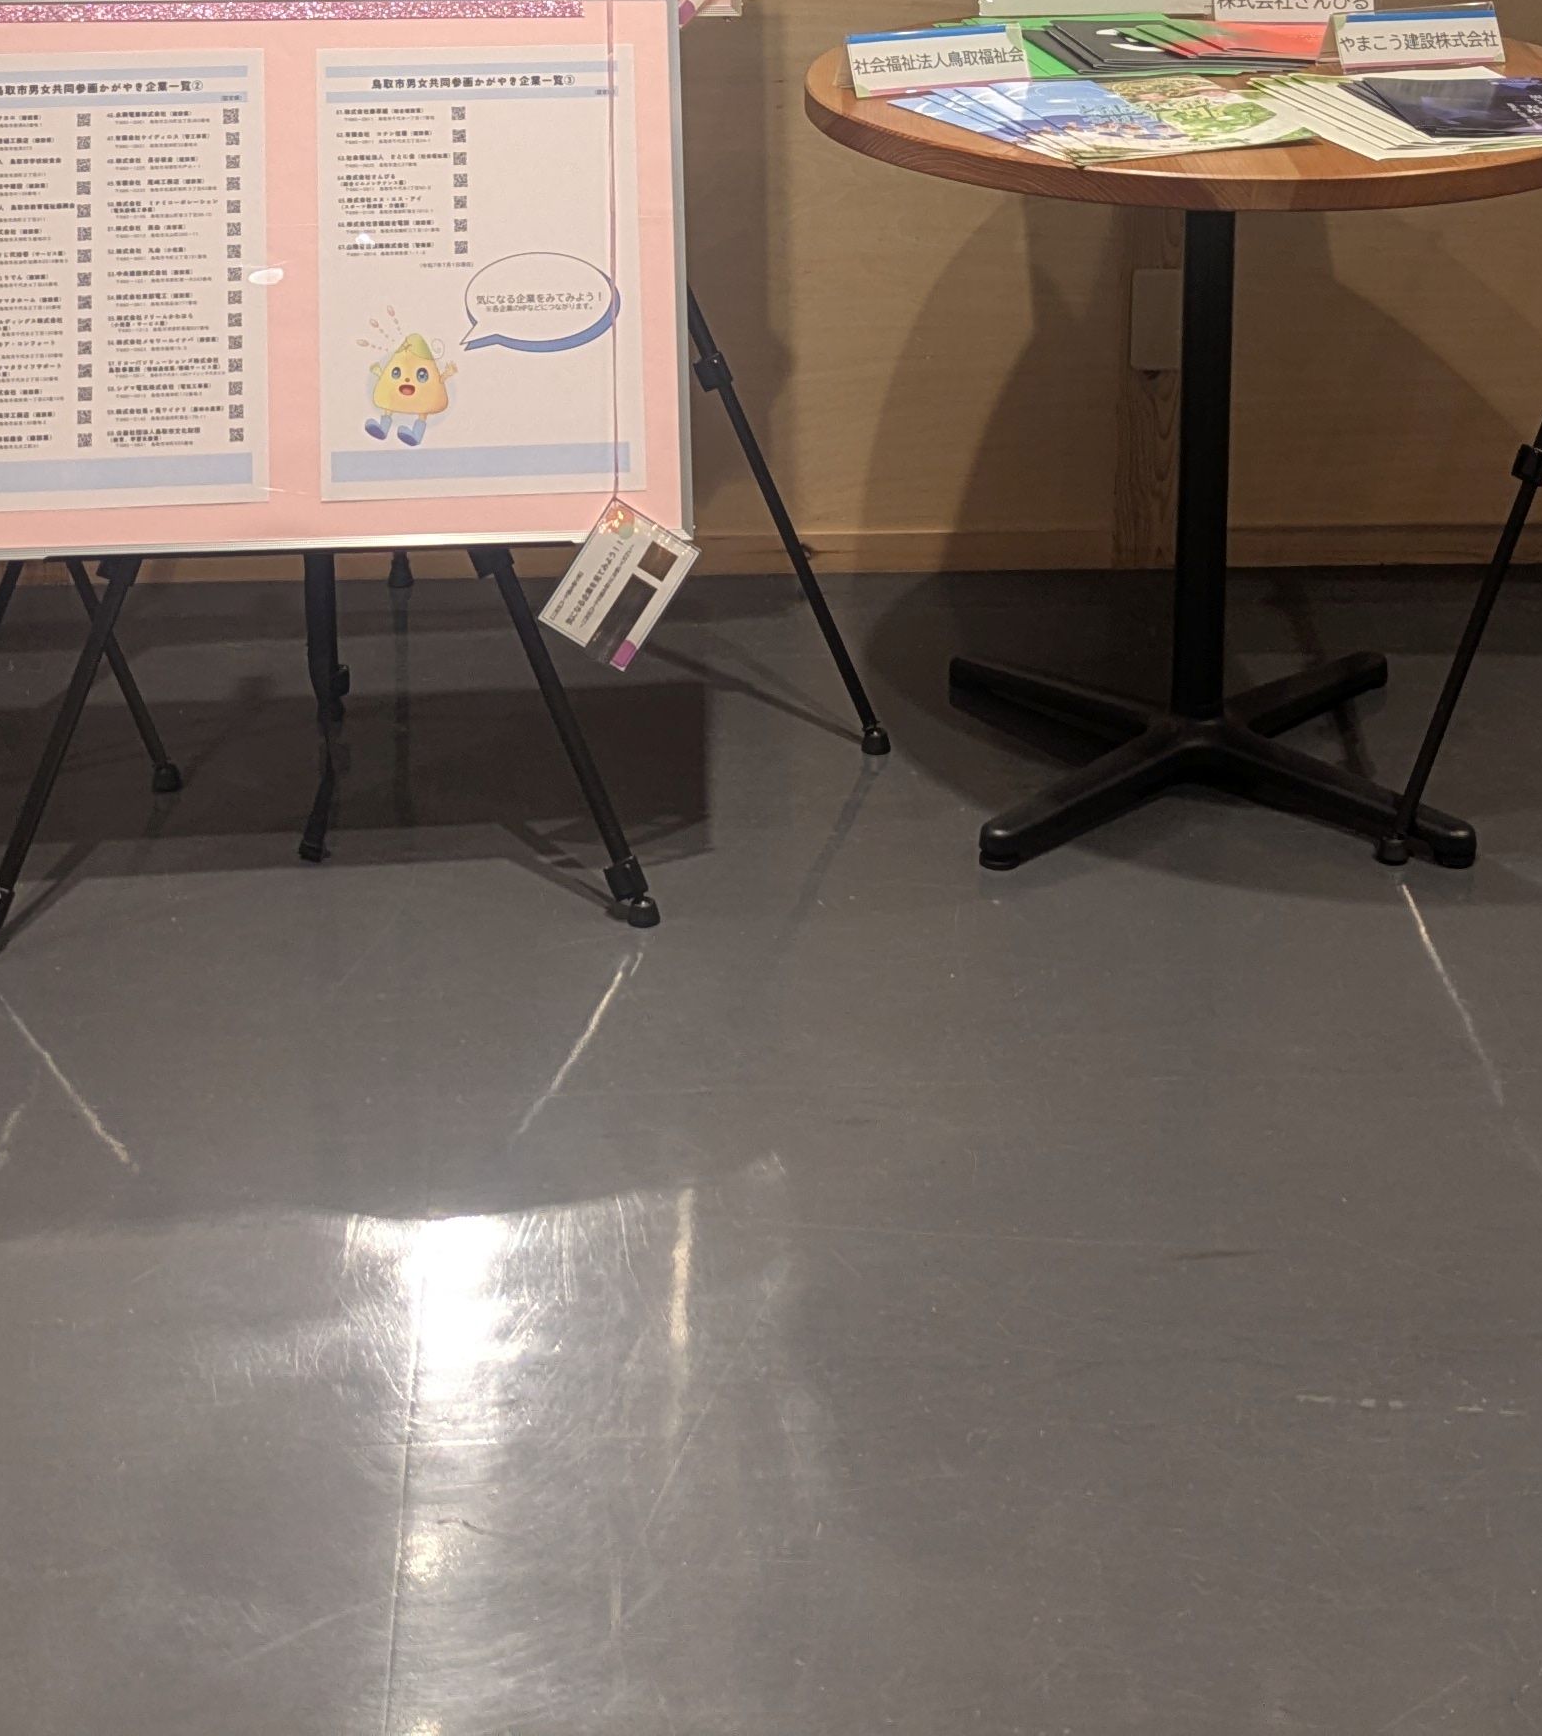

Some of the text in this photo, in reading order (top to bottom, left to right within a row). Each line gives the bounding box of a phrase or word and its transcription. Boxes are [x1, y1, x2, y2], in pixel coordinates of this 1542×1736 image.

[1338, 29, 1500, 54] やまこう建設株式会社
[852, 44, 1026, 75] 社会福祉法人鳥取福祉会
